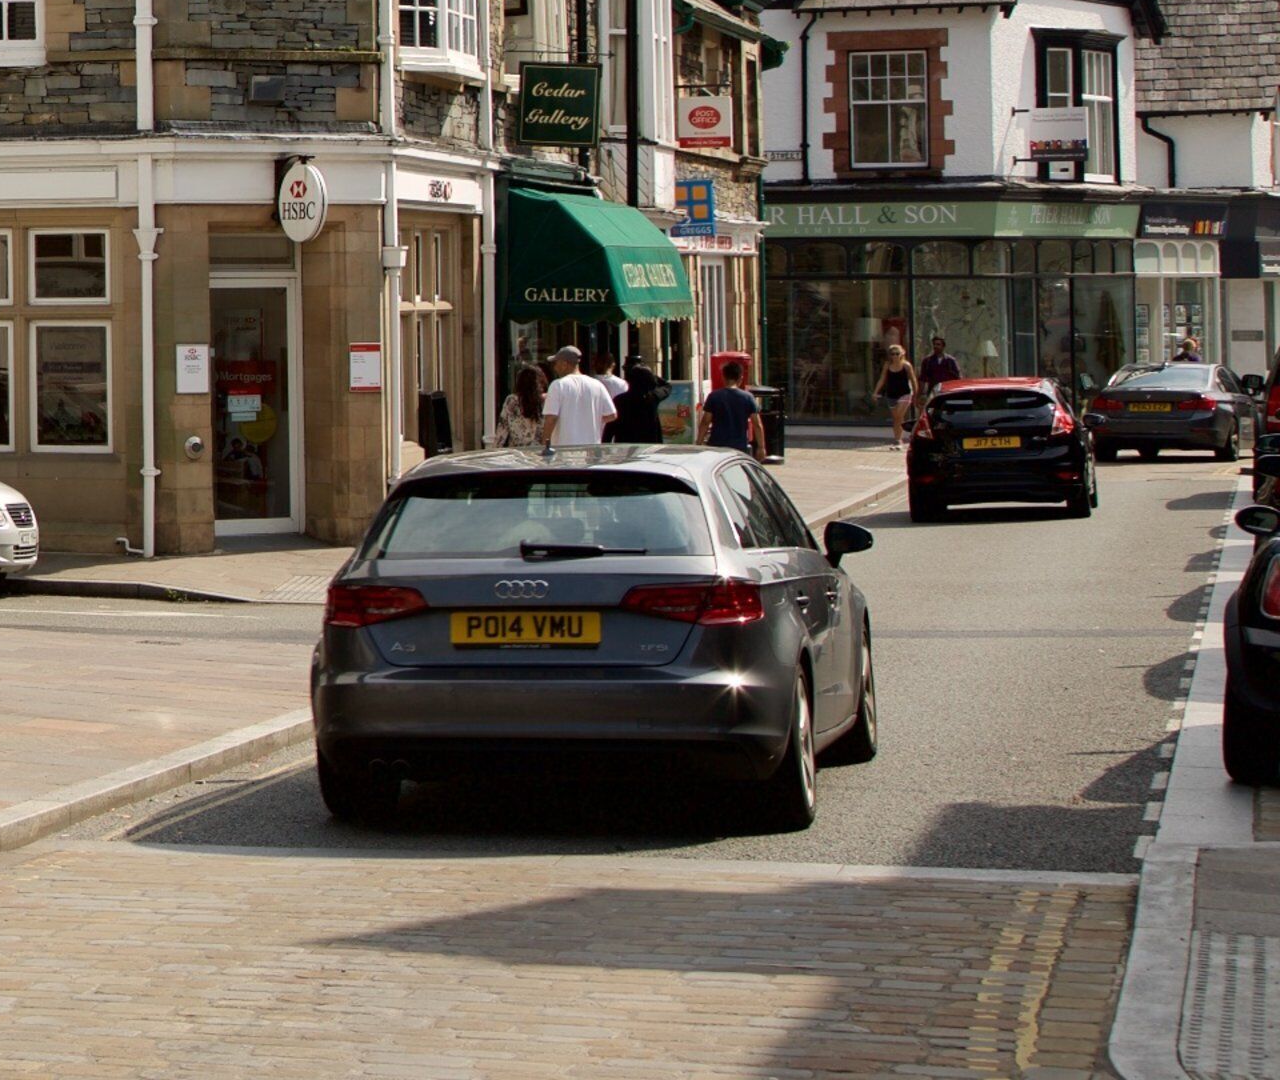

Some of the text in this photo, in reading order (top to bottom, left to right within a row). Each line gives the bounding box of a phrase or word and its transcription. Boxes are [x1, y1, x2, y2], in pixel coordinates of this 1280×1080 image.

[532, 82, 586, 98] Cedar
[525, 109, 591, 130] Gallery
[282, 201, 316, 220] HSBC
[797, 206, 870, 225] HALL
[877, 205, 896, 224] &
[904, 204, 959, 224] SON
[680, 226, 711, 235] GREGGS
[524, 287, 609, 302] GALLERY
[220, 371, 273, 383] Mortgages
[466, 615, 584, 639] PO14 VMU
[391, 641, 416, 652] A3
